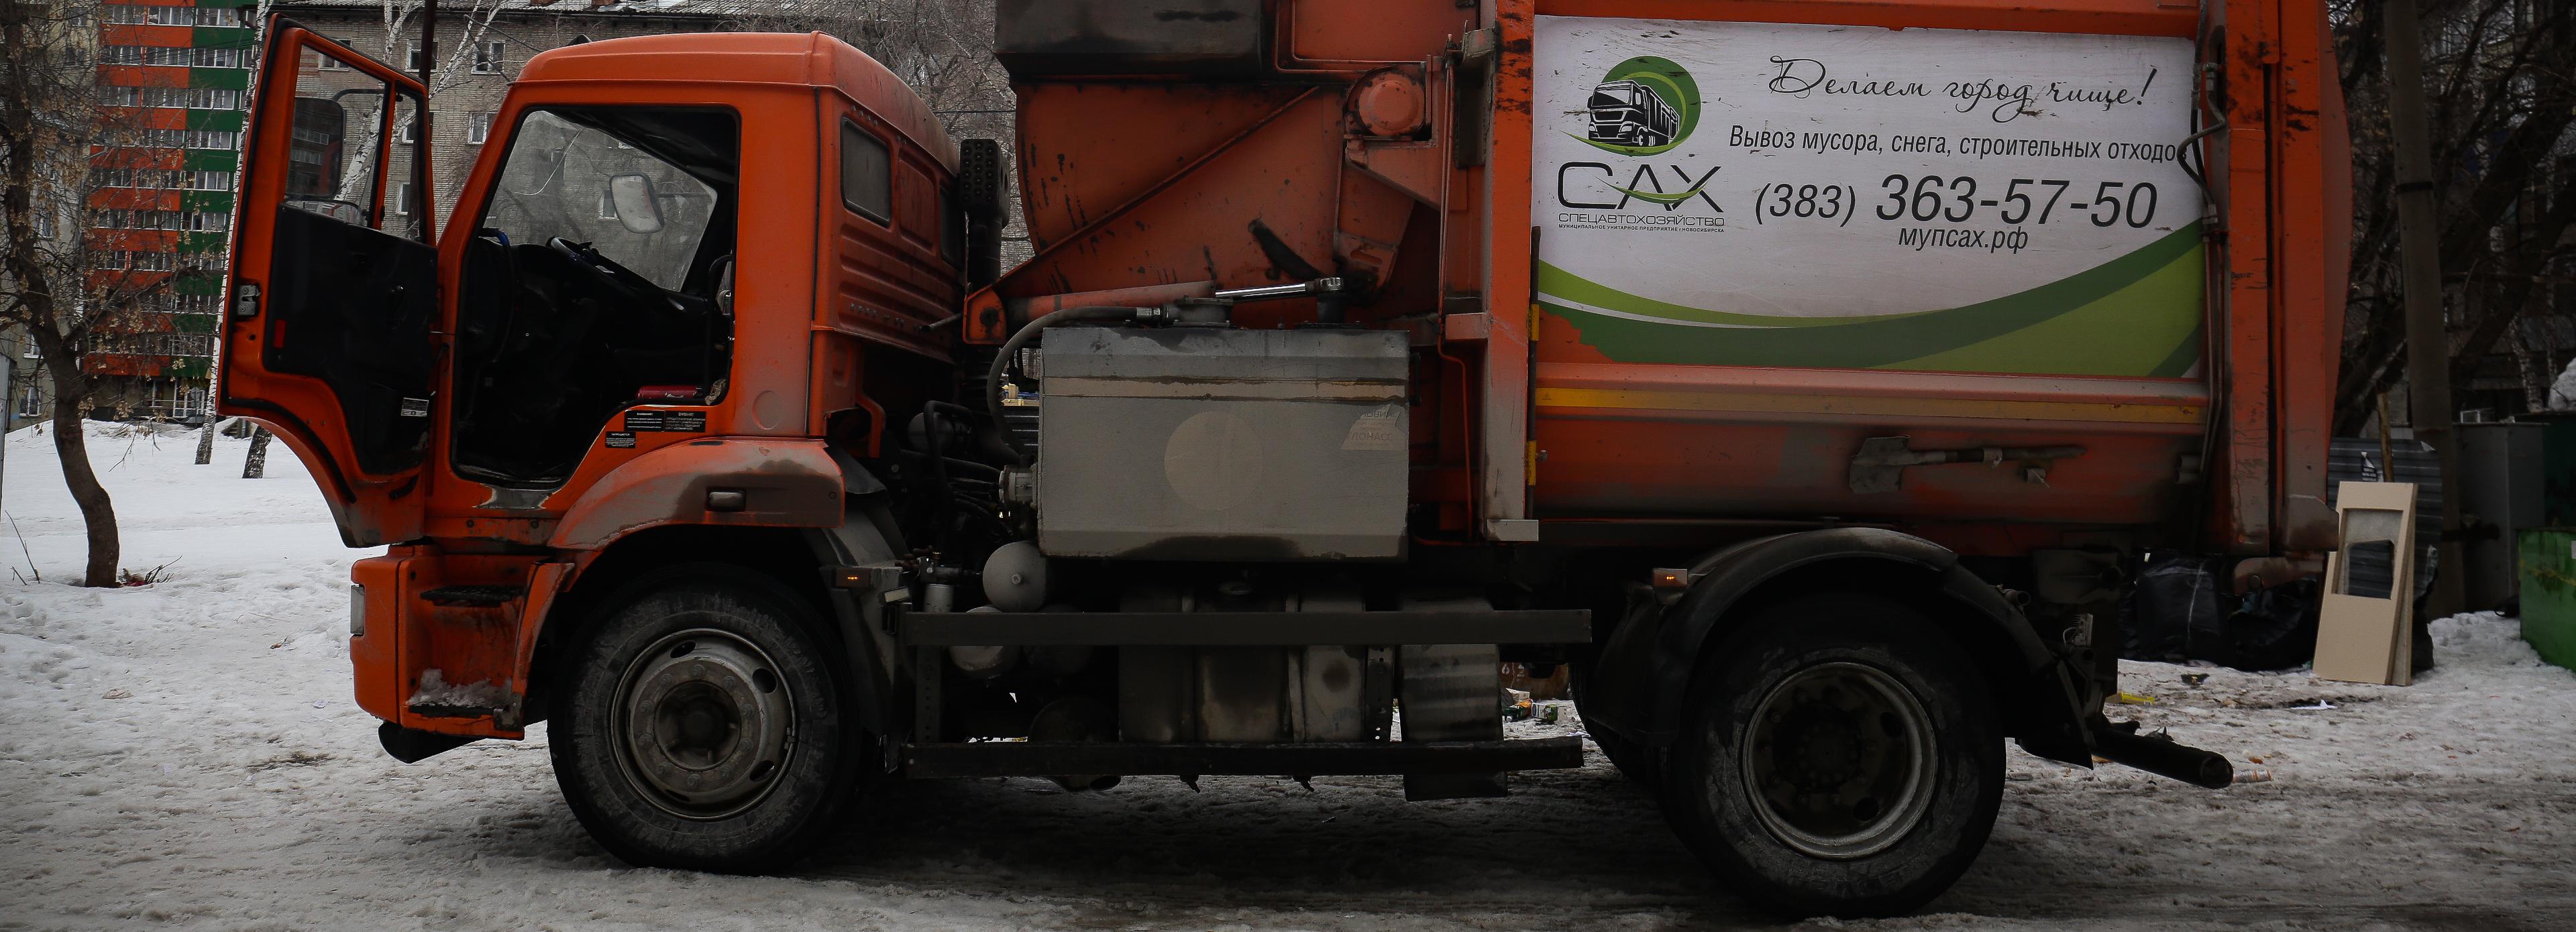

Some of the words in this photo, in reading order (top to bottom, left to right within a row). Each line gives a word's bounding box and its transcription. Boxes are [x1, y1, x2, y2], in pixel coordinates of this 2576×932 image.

[1768, 55, 1932, 99] Делаем
[1942, 78, 2033, 123] город
[2045, 68, 2157, 112] чище!
[1729, 125, 1795, 148] Вывоз
[1802, 132, 1883, 155] мусора,
[1890, 134, 1951, 156] снега,
[1960, 137, 2102, 160] строительных
[1557, 162, 1725, 213] САХ
[1755, 182, 1856, 227] (383)
[1876, 174, 2157, 229] 363-57-50
[1558, 213, 1725, 227] СПЕЦАВТОХОЗЯЙСТВО
[1898, 226, 2029, 254] мупсах.рф
